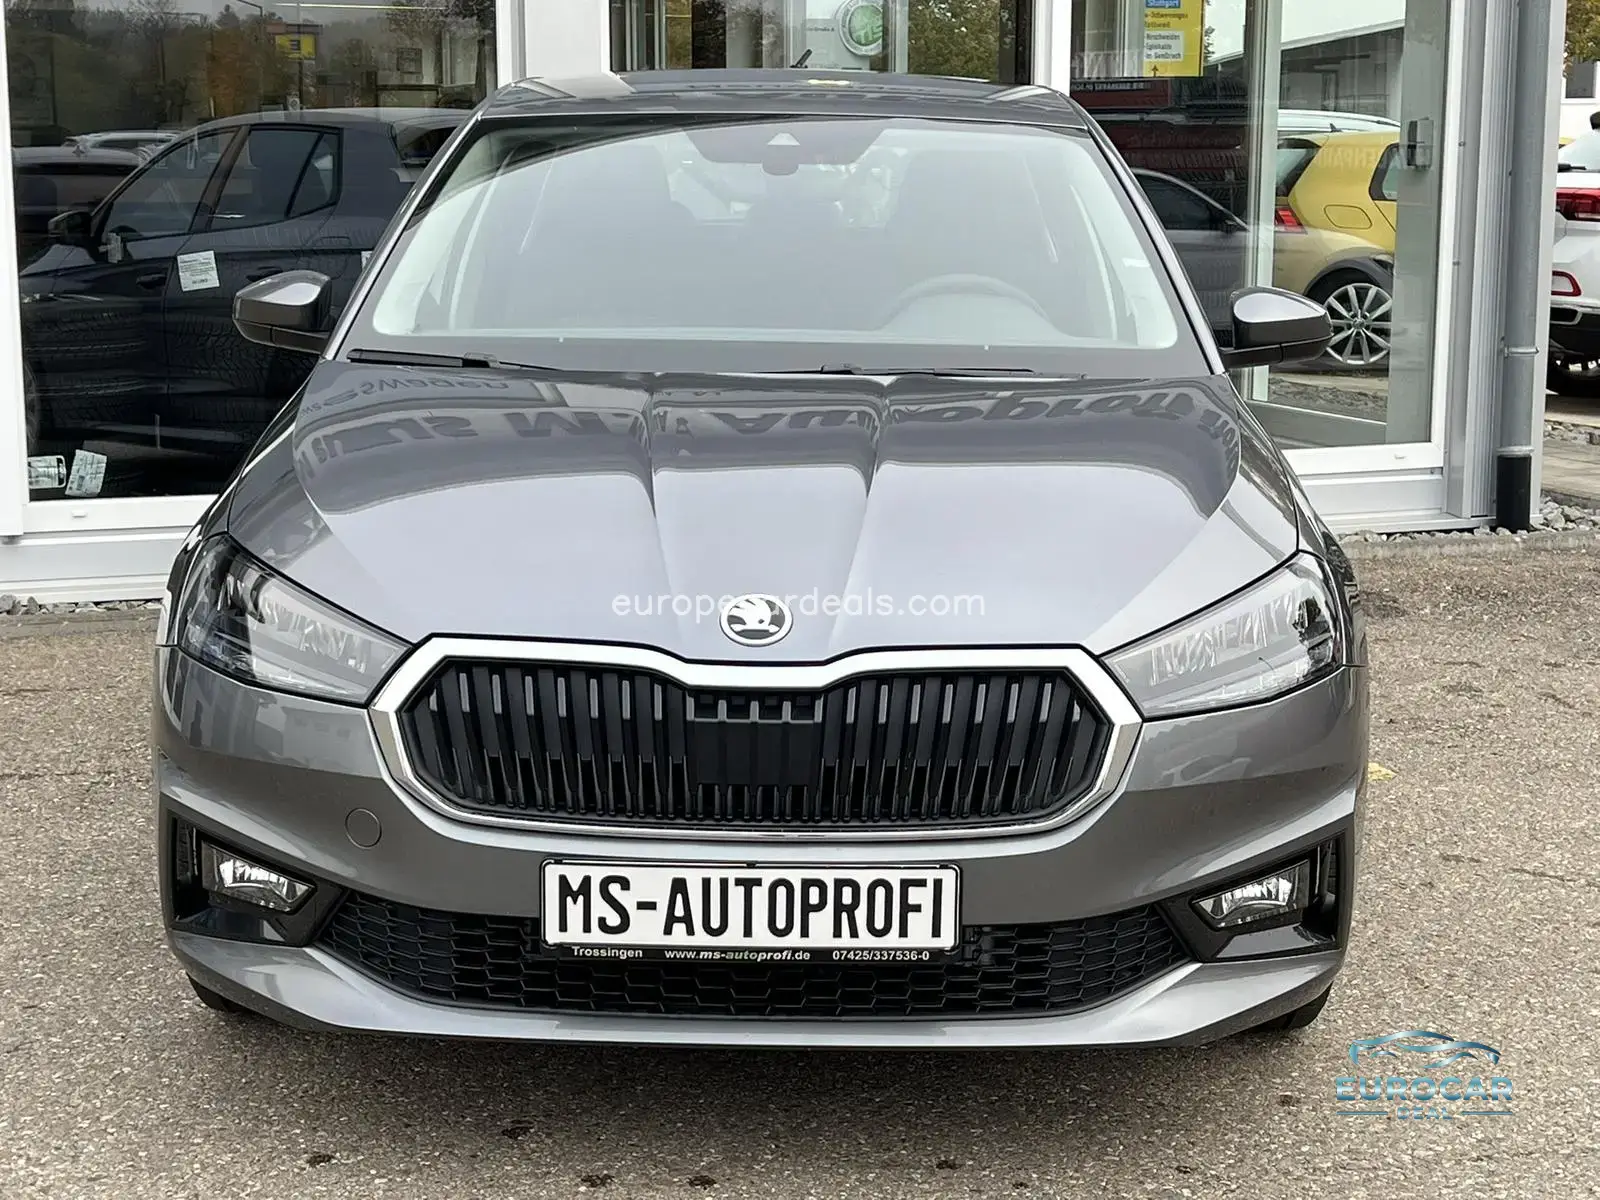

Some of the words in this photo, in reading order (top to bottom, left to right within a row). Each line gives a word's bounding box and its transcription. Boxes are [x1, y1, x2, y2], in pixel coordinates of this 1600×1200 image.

[558, 874, 943, 939] MS-AUTOPROFI
[572, 946, 643, 959] Trossingen
[664, 949, 811, 962] www.ms-autoprofi.de
[832, 950, 930, 962] 07425/337536-0
